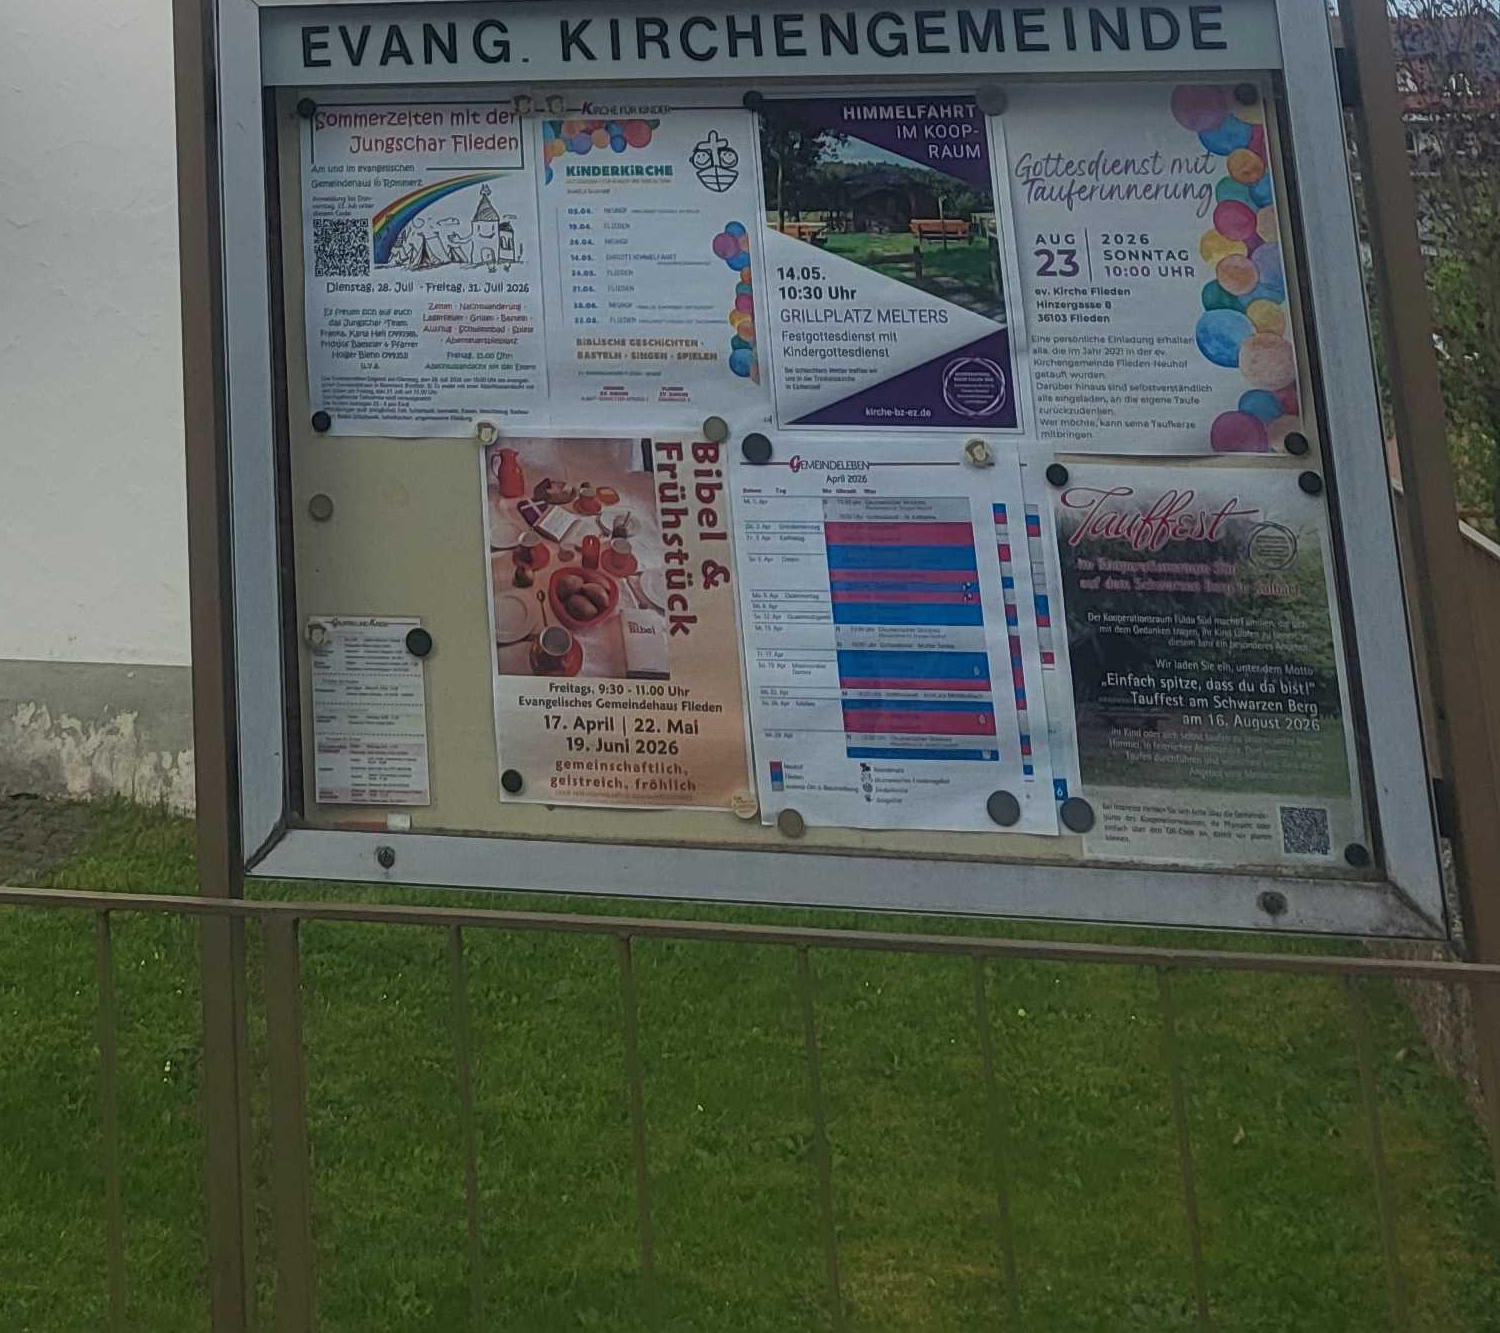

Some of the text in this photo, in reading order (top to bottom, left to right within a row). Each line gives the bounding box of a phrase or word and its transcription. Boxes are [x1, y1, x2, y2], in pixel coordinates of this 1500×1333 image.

[301, 5, 1229, 68] EVANG. KIRCHENGEMEINDE
[450, 109, 480, 125] mit
[486, 109, 516, 124] der
[844, 104, 975, 120] HIMMELFAHRT
[897, 125, 979, 138] IM KOOP-
[350, 135, 519, 153] Jungschar Flieden
[929, 144, 981, 158] RAUM
[1015, 150, 1215, 181] Gottesdienst mit
[1022, 179, 1212, 218] Tauferinnerung
[1035, 234, 1075, 245] AUG
[1102, 234, 1149, 245] 2026
[1103, 250, 1188, 261] SONNTAG
[1034, 249, 1079, 277] 23
[777, 267, 825, 280] 14.05.
[1105, 266, 1195, 277] 10:00 UHR
[327, 283, 374, 293] Dienstag,
[378, 283, 392, 292] 28.
[395, 282, 413, 293] Juli
[427, 282, 465, 293] Freitag,
[468, 283, 481, 292] 31.
[484, 282, 503, 293] Juli
[507, 283, 529, 293] 2026
[779, 286, 856, 299] 10:30 Uhr
[1053, 287, 1087, 295] Kirche
[1091, 287, 1130, 295] Flieden
[781, 309, 948, 323] GRILLPLATZ MELTERS
[1037, 314, 1110, 323] 36103 Flieden
[782, 331, 897, 343] Festgottesdienst mit
[1108, 336, 1154, 345] Einladung
[783, 346, 889, 359] Kindergottesdienst
[826, 474, 867, 484] April 2026
[691, 441, 730, 589] Bibel &
[1061, 487, 1259, 550] Tauffest
[655, 442, 697, 636] Frühstück
[1156, 659, 1171, 669] Wir
[1174, 660, 1198, 670] laden
[1201, 661, 1214, 671] Sie
[599, 684, 624, 695] 9:30
[668, 686, 690, 697] Uhr
[1160, 677, 1202, 691] spitze,
[1206, 678, 1234, 692] dass
[1239, 680, 1255, 692] du
[1259, 681, 1276, 693] da
[519, 696, 722, 712] Evangelisches Gemeindehaus Flieden
[1131, 692, 1318, 715] Tauffest am Schwarzen Berg
[543, 715, 568, 729] 17.
[573, 716, 614, 734] April
[634, 719, 660, 733] 22.
[667, 719, 698, 734] Mai
[1183, 714, 1320, 731] am 16. August 2026
[566, 738, 678, 754] 19. Juni 2026
[636, 778, 697, 791] fröhlich
